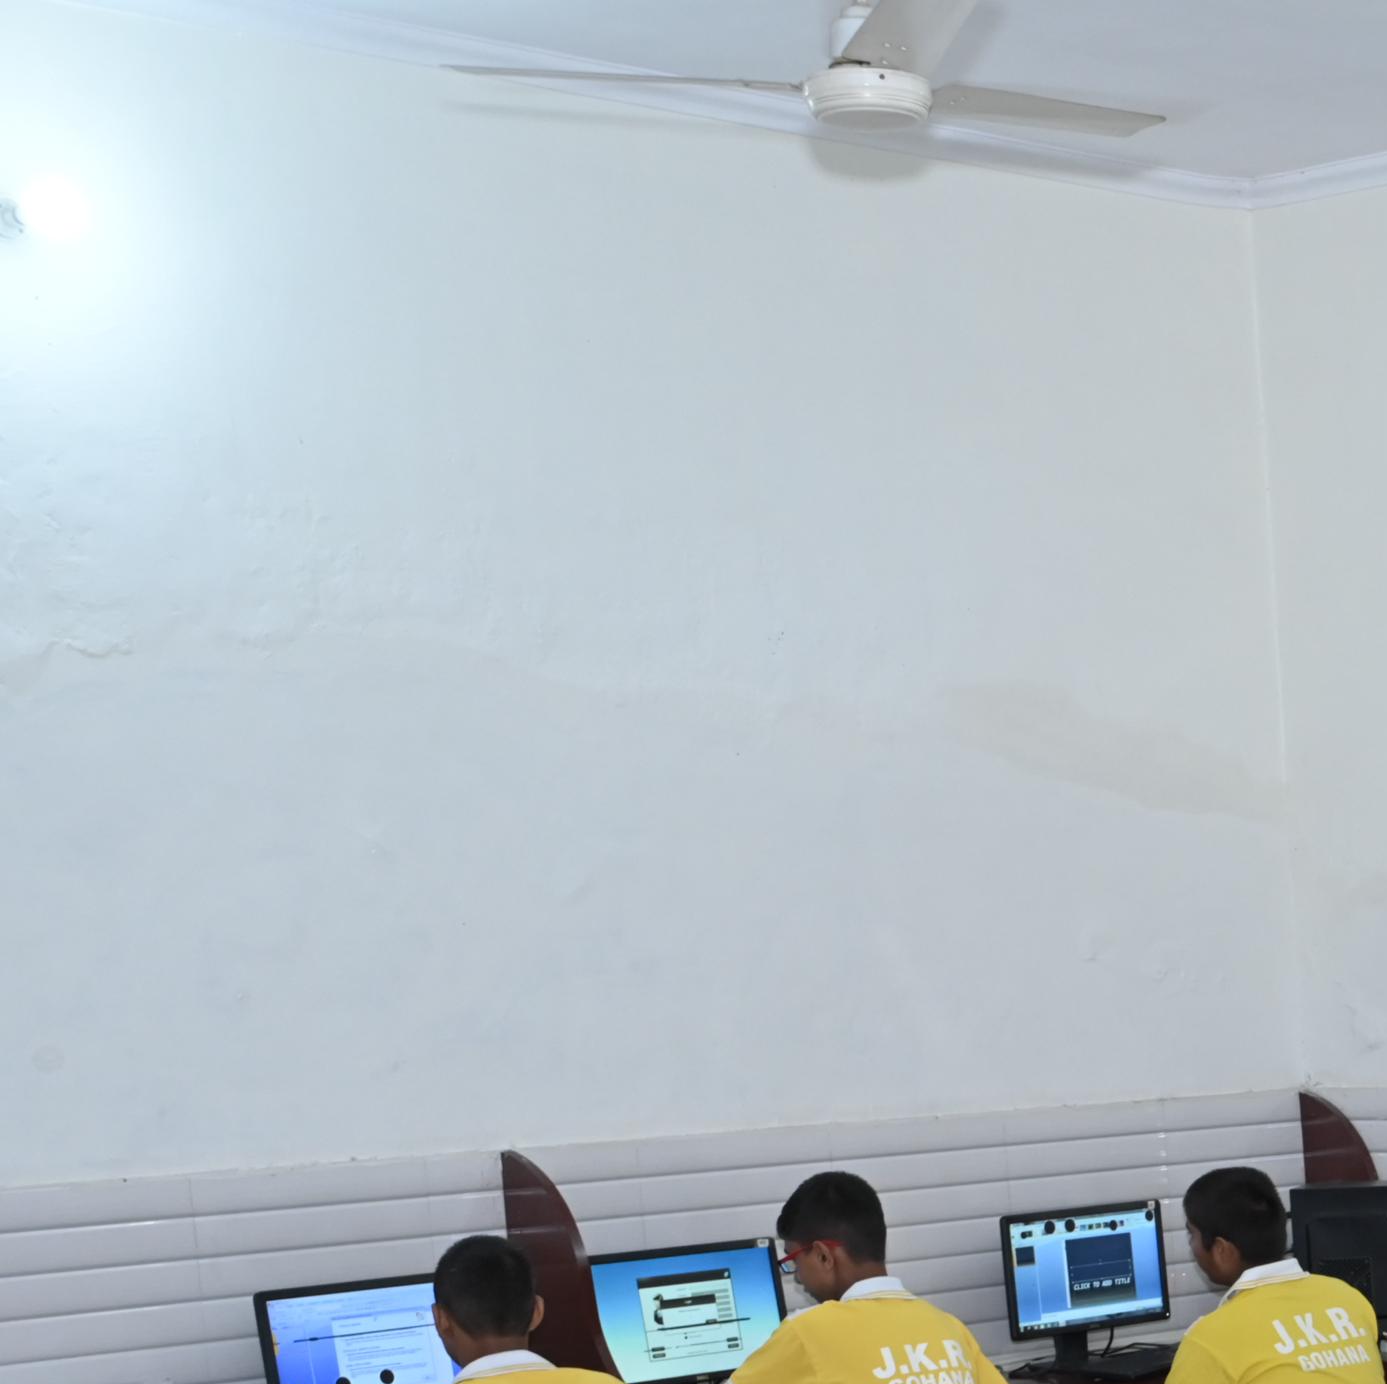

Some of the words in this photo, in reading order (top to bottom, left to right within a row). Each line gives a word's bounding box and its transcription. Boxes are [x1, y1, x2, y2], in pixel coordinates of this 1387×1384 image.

[1073, 1282, 1091, 1291] CLICK
[1101, 1279, 1113, 1287] ADD
[1114, 1276, 1131, 1285] TITLE
[1271, 1307, 1367, 1354] J.K.R.
[1298, 1344, 1370, 1372] GOHANA
